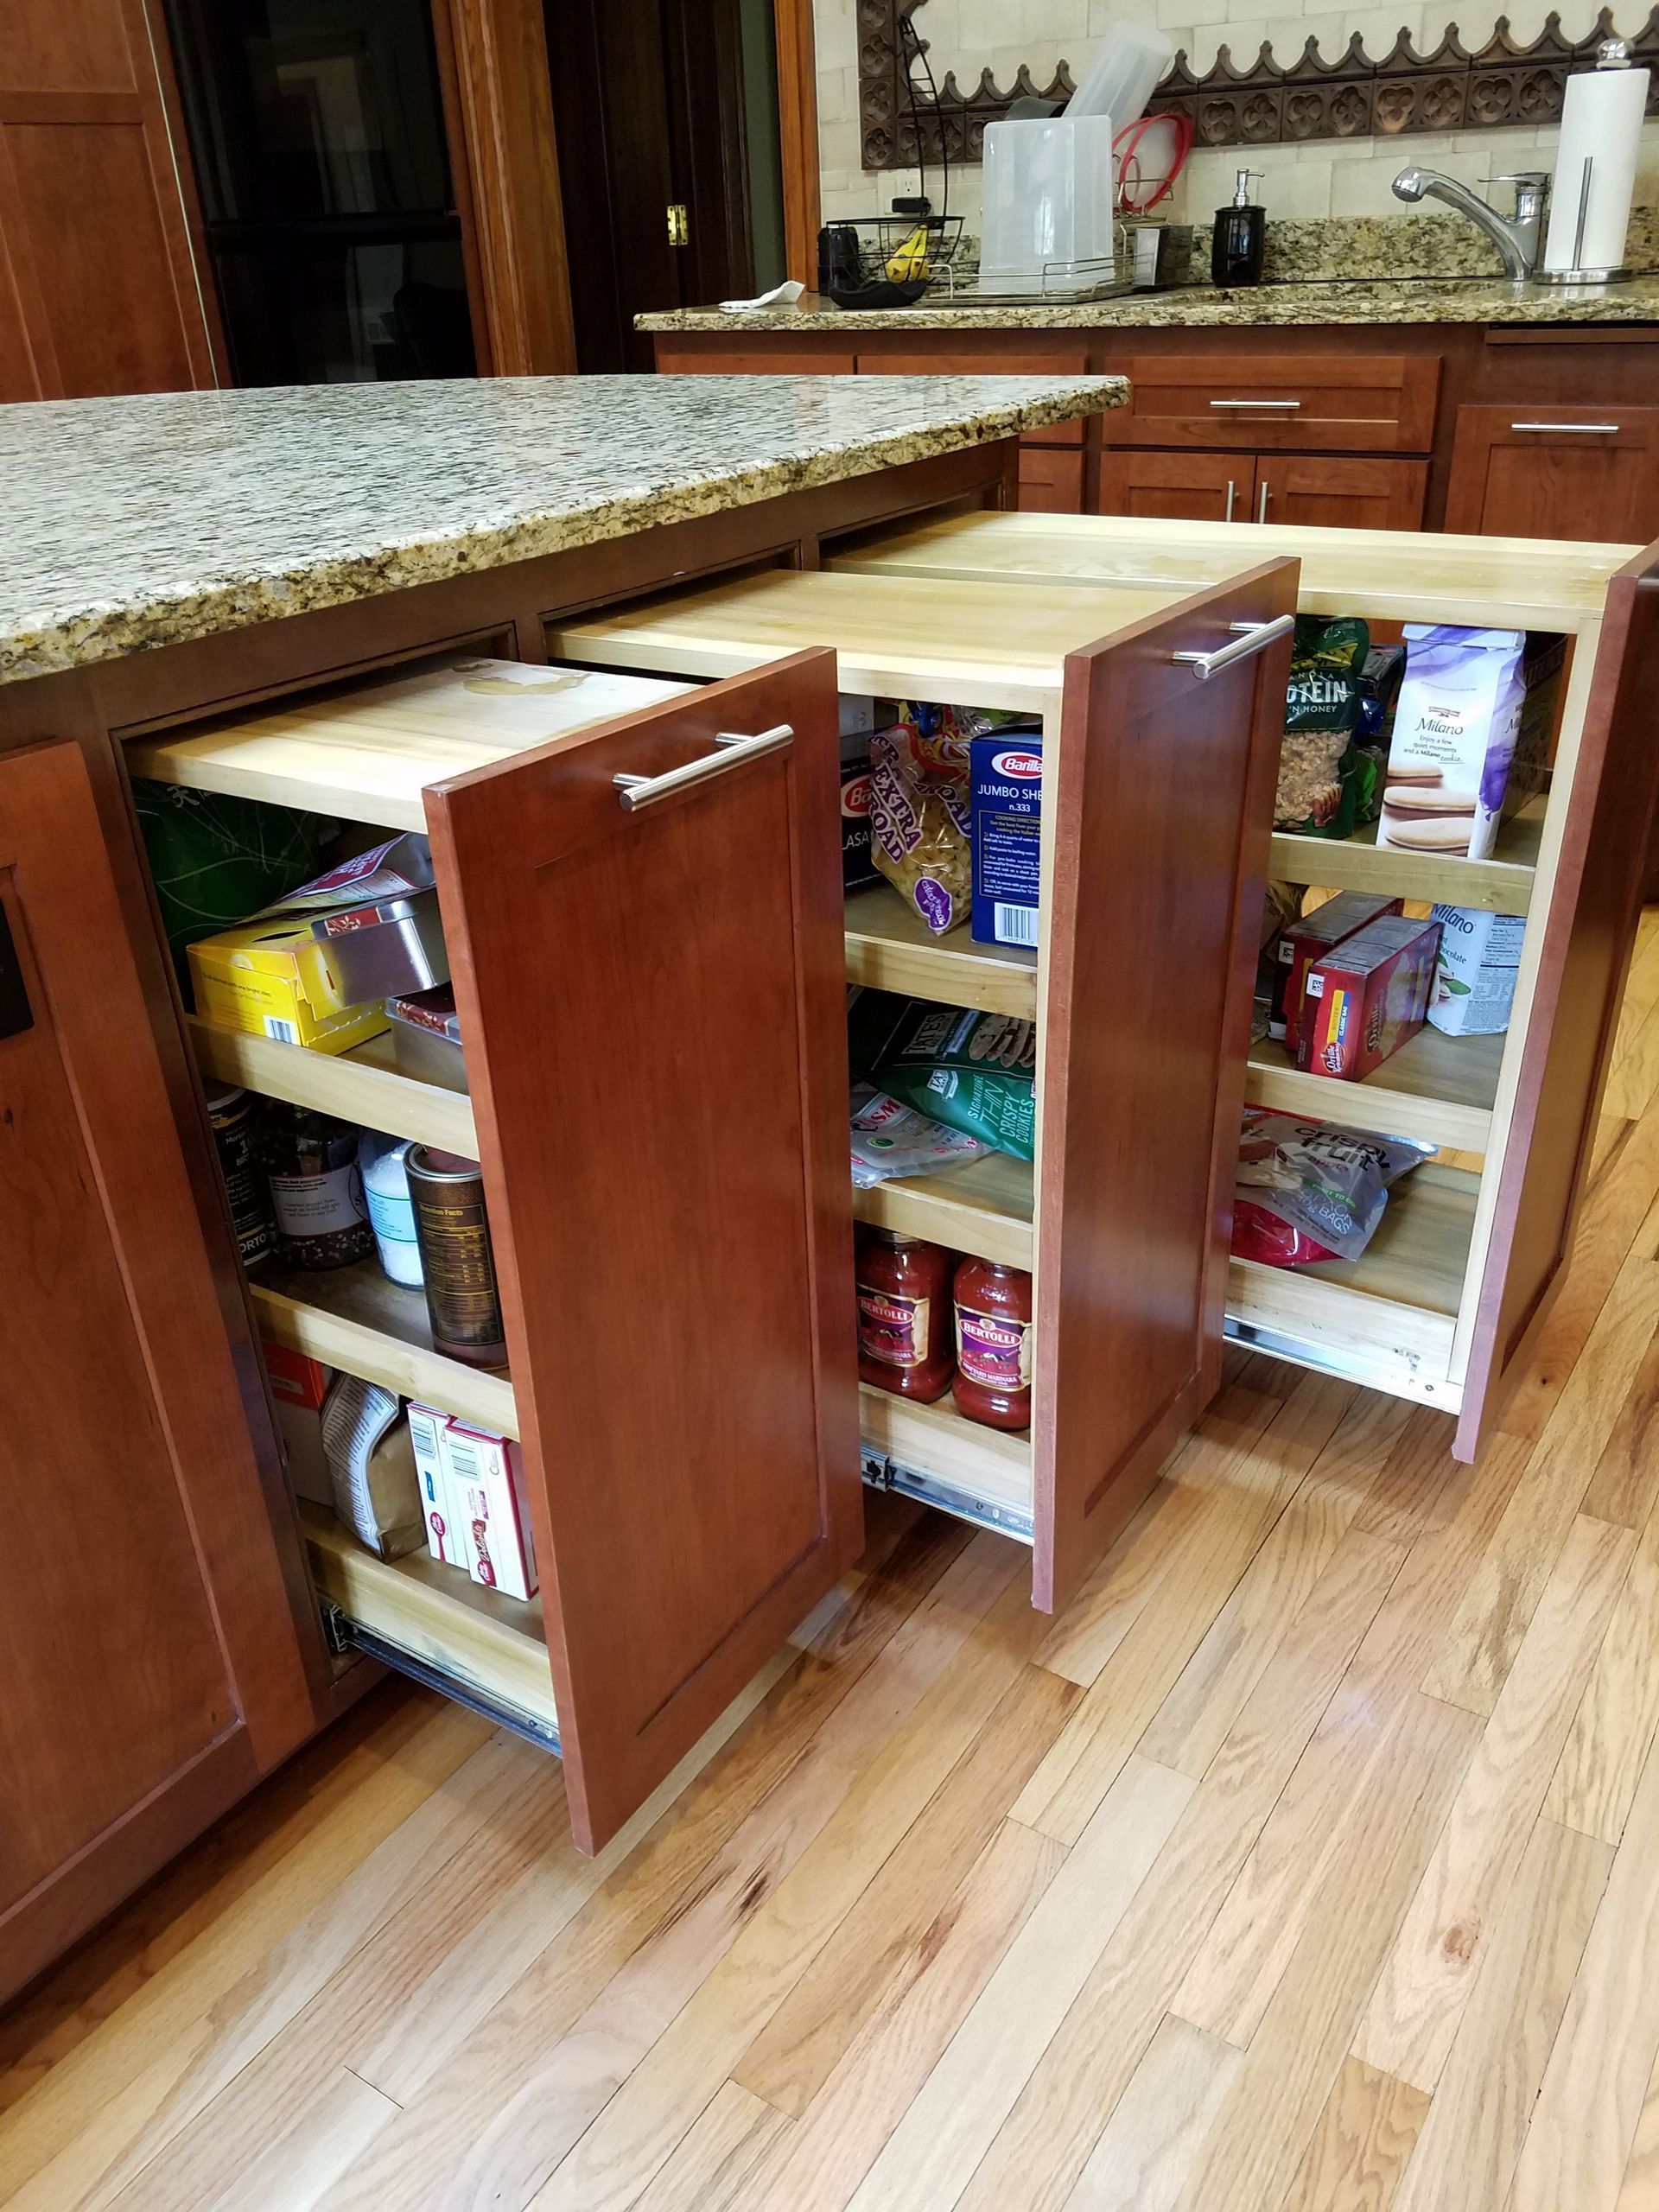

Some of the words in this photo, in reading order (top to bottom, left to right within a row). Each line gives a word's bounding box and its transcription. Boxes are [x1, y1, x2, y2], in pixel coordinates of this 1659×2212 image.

[1414, 717, 1464, 735] Milano
[1420, 734, 1434, 744] Enjoy
[1004, 758, 1043, 772] Barilla
[977, 784, 1020, 798] JUMBO
[874, 765, 922, 850] EXTRA
[1009, 803, 1031, 812] n.333
[968, 1074, 984, 1120] SIGNATURE
[979, 1079, 1004, 1127] THIN
[1000, 1091, 1020, 1138] CRISPY
[1016, 1099, 1035, 1144] COOKIES
[1294, 1128, 1391, 1169] crispy
[1301, 1137, 1371, 1172] fruit
[1319, 1206, 1350, 1235] BAGS
[861, 1298, 908, 1321] BERTOLLI
[963, 1321, 1015, 1344] BERTOLLI
